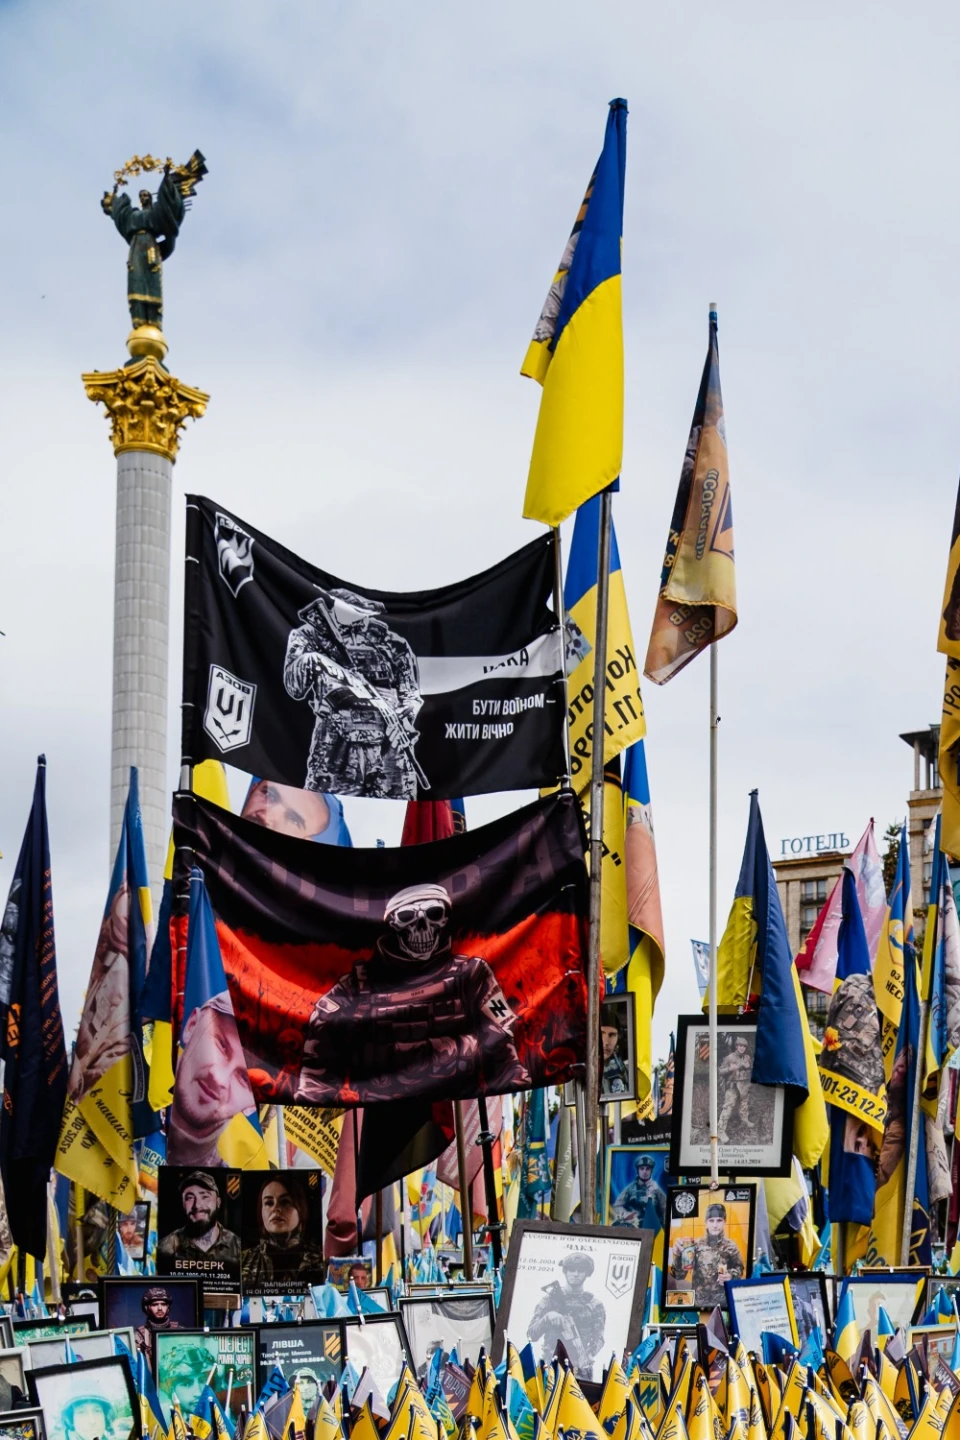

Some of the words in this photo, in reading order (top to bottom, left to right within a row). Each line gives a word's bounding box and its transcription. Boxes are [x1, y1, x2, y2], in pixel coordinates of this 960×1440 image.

[216, 671, 251, 695] АЗОВ
[472, 700, 501, 716] БУТИ
[502, 693, 545, 715] ВОЇНОМ
[445, 723, 479, 740] ЖИТИ
[482, 722, 514, 739] ВІЧНО
[780, 832, 850, 855] ГОТЕЛЬ
[175, 1260, 225, 1271] БЕРСЕРК
[271, 1339, 304, 1350] ЛІВША
